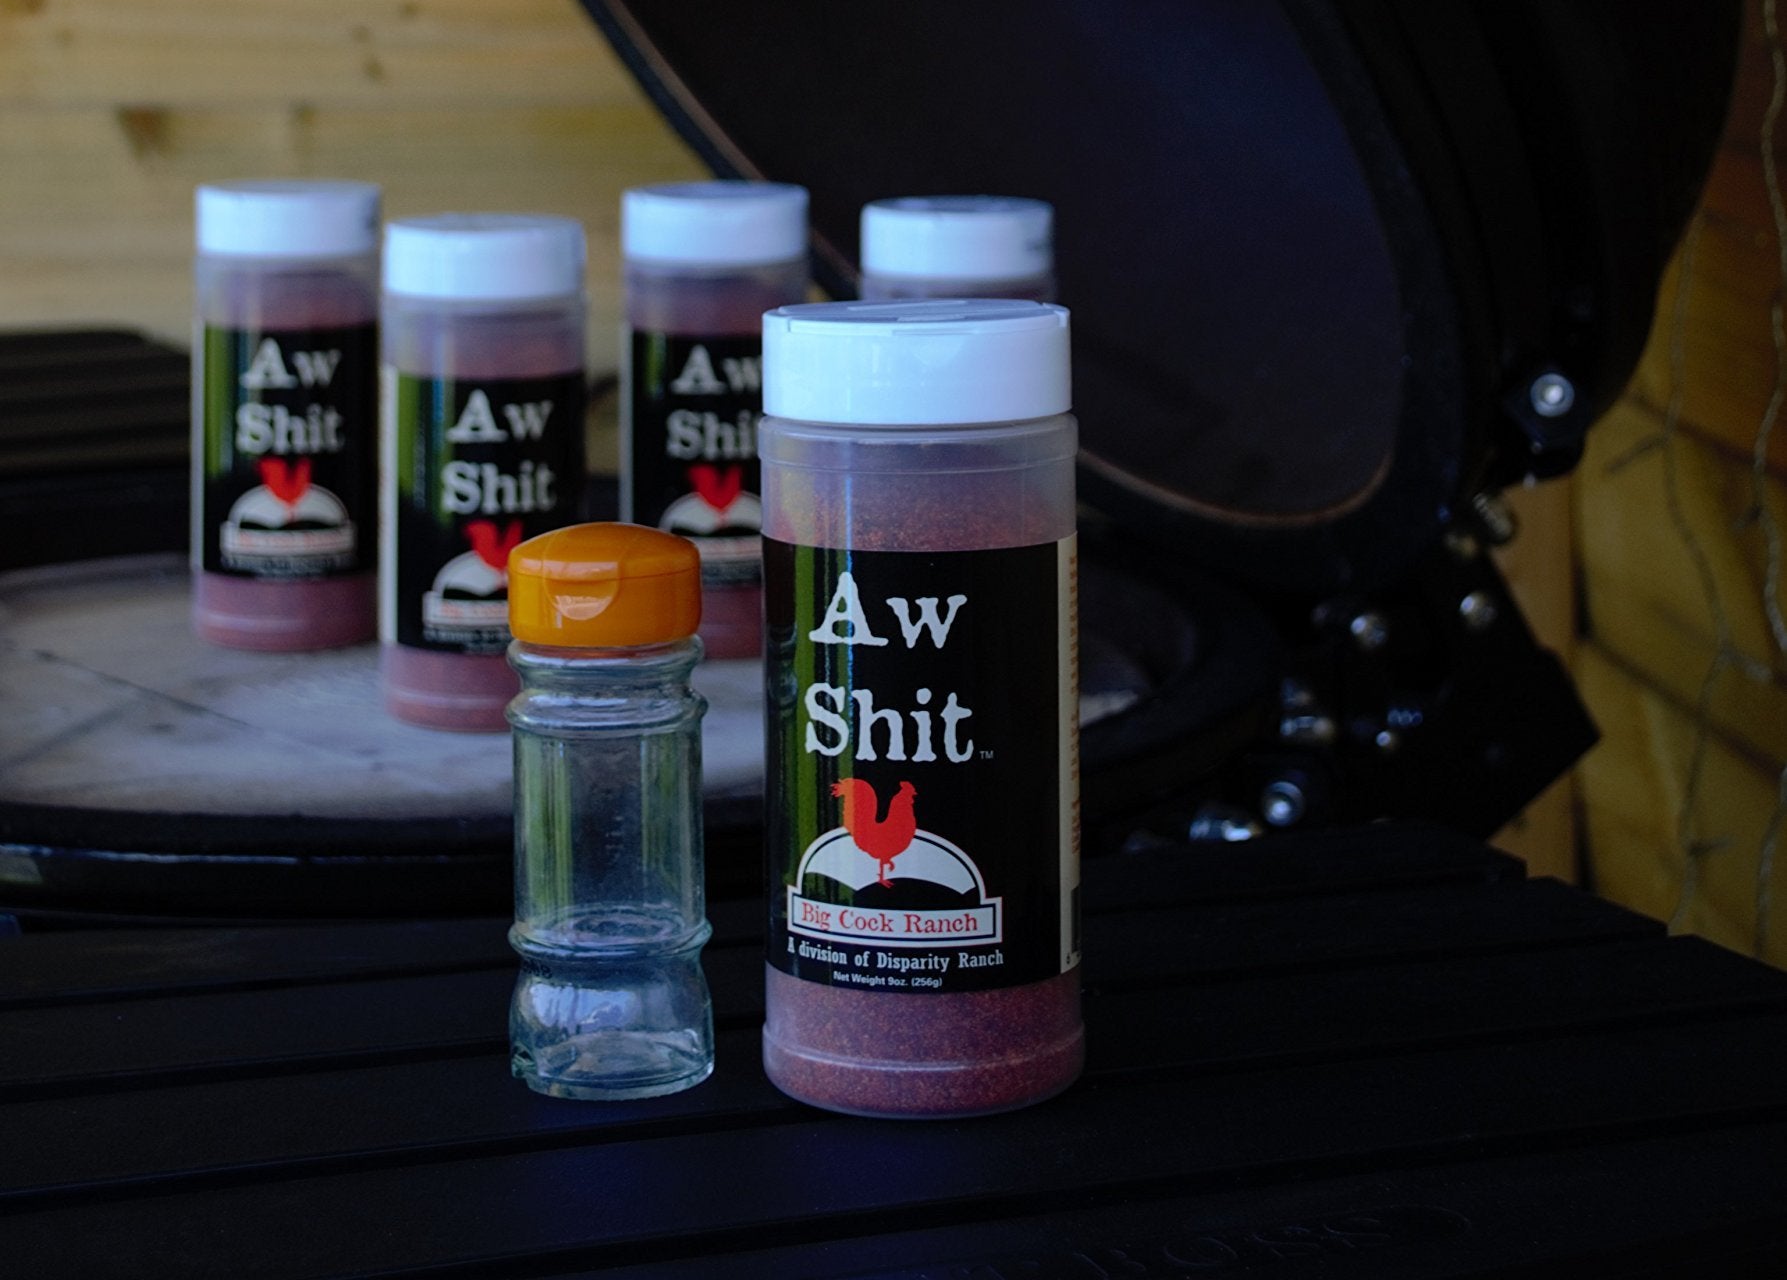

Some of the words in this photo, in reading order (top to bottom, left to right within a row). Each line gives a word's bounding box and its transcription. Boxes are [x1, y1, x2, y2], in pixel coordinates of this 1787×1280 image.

[238, 336, 343, 390] Aw
[234, 401, 346, 455] Shit
[445, 387, 555, 444] Aw
[665, 407, 759, 461] Shi
[440, 458, 557, 516] Shit
[809, 571, 967, 649] Aw
[805, 682, 974, 763] Shit
[802, 902, 831, 931] Big
[839, 910, 894, 933] Cock
[904, 913, 978, 934] Ranch
[786, 935, 796, 955] A
[798, 940, 848, 966] division
[854, 950, 871, 968] of
[877, 951, 950, 973] Disparity
[958, 949, 1004, 969] Ranch
[833, 970, 849, 983] Net
[851, 973, 885, 987] Weight
[887, 976, 909, 987] 9oz.
[911, 976, 943, 989] (256g)
